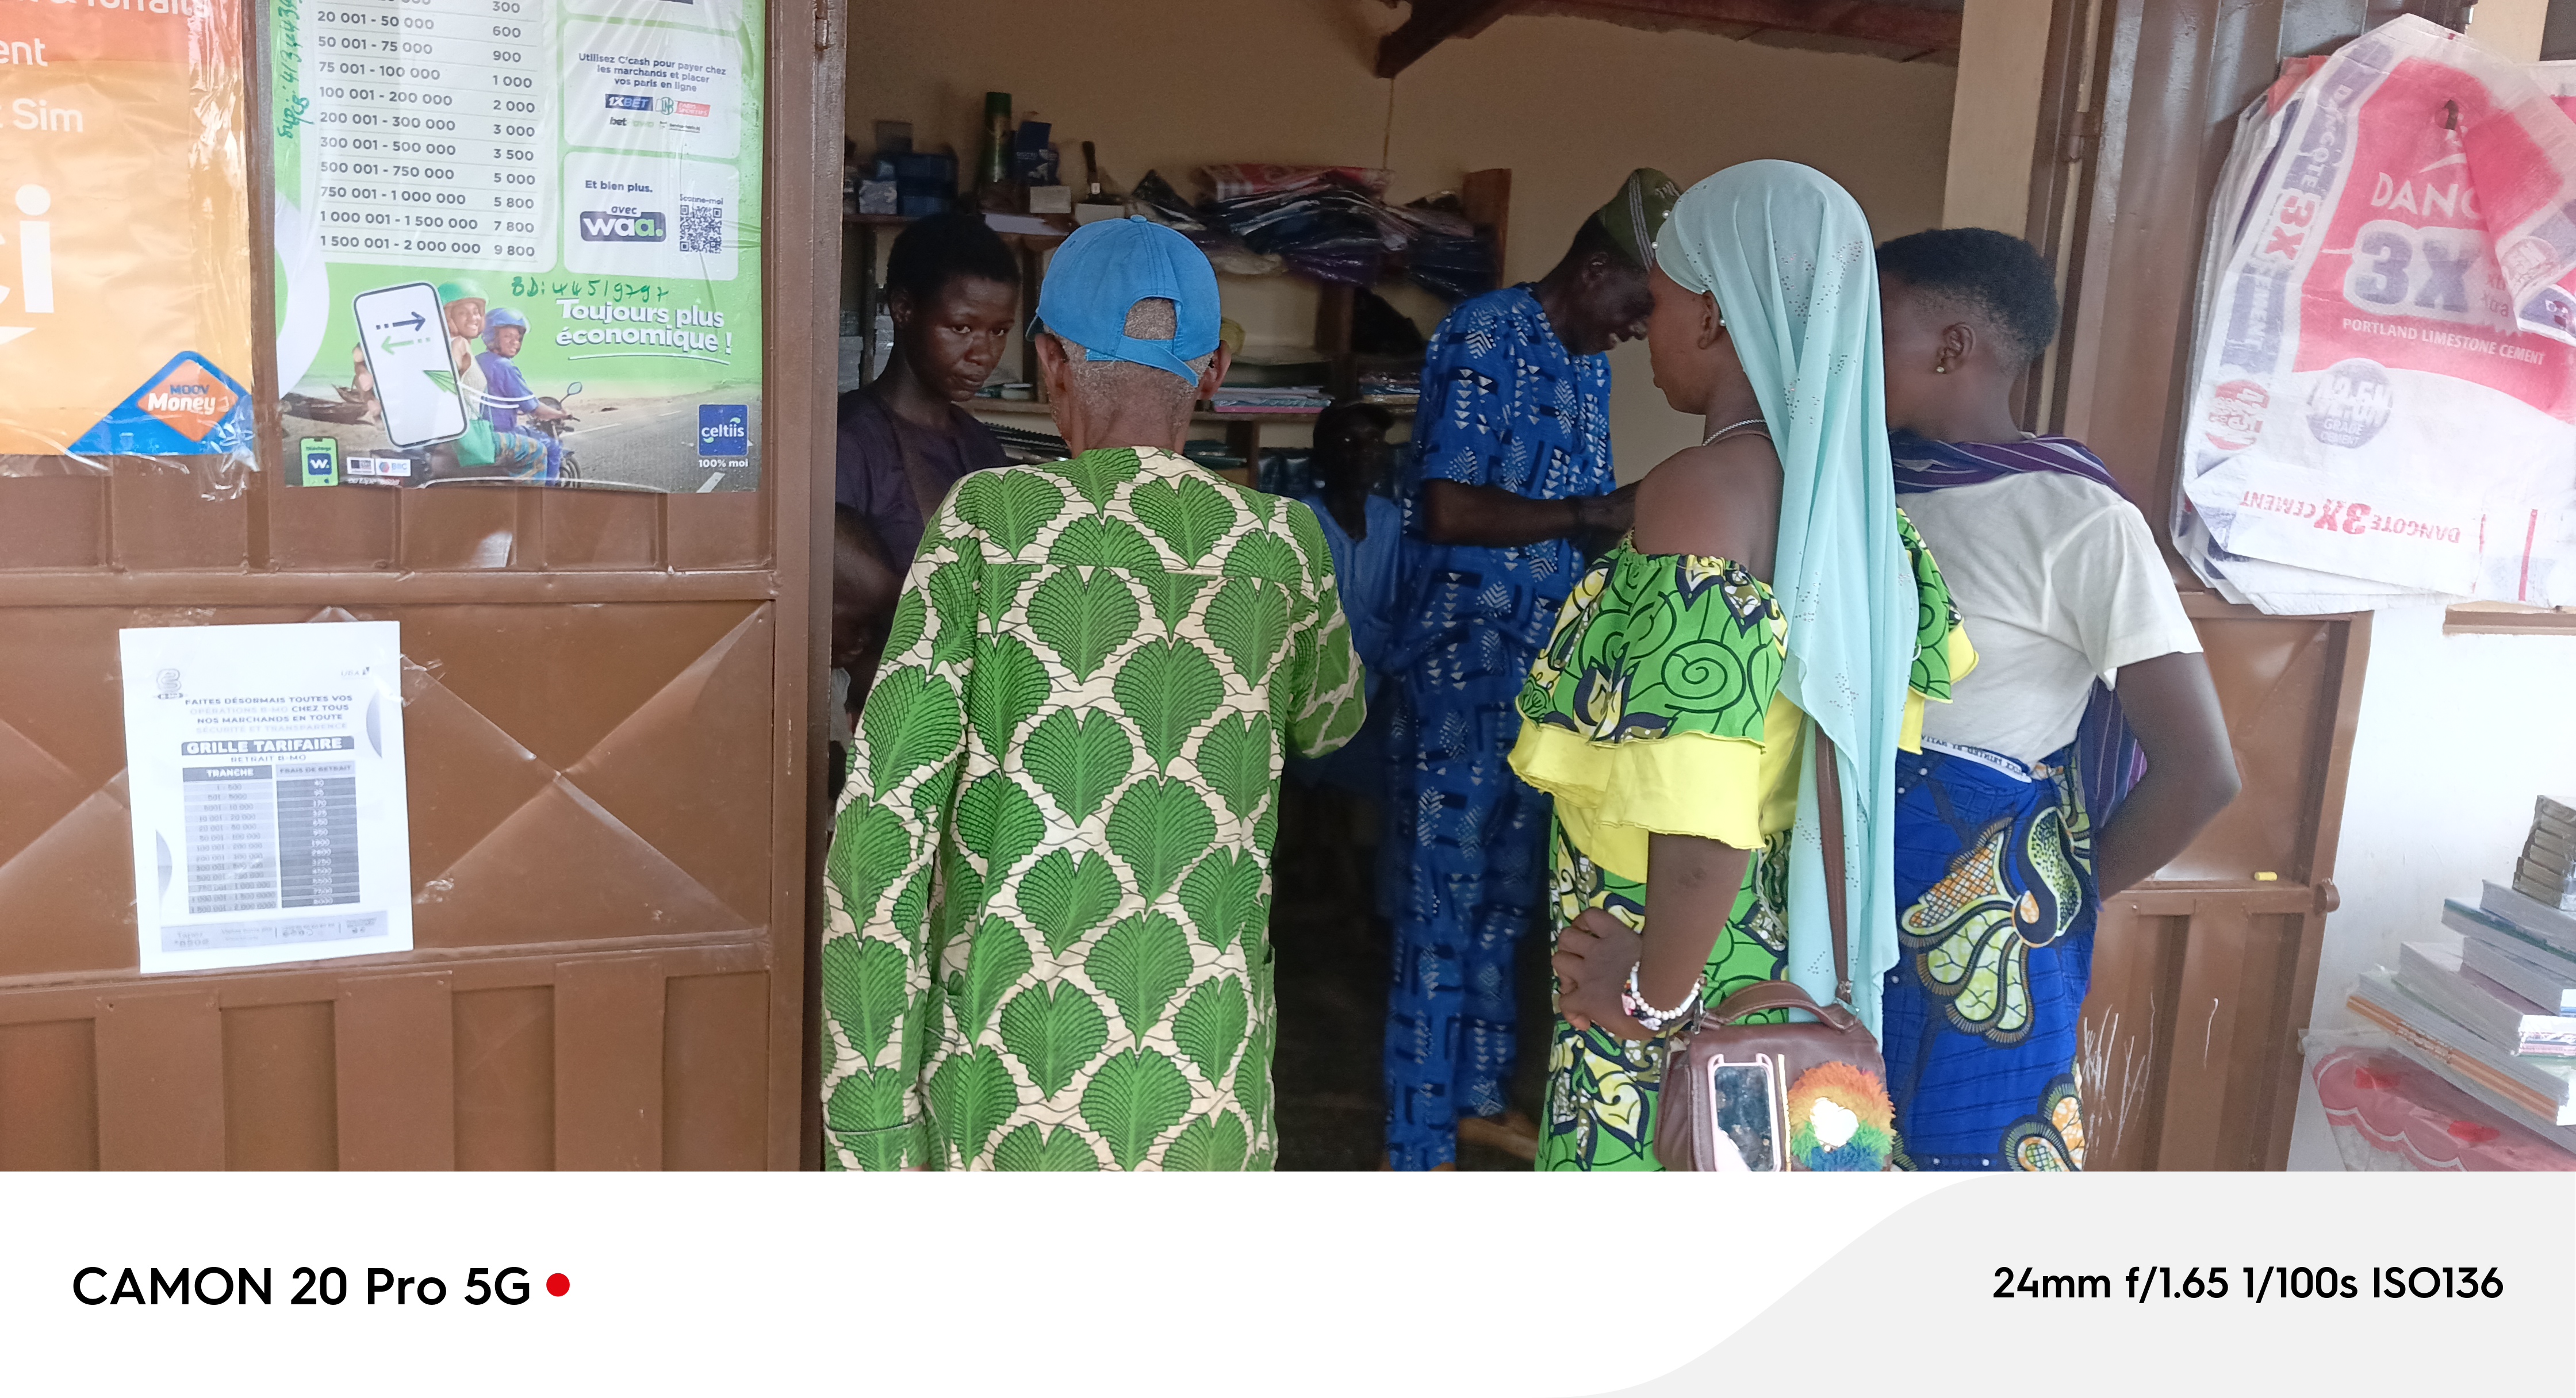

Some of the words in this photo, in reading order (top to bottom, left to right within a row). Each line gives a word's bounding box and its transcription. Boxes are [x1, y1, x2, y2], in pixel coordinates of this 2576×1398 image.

[492, 1, 520, 13] 300
[317, 10, 336, 22] 20
[340, 12, 366, 25] 001
[380, 15, 400, 27] 50
[404, 17, 435, 30] 000
[492, 25, 522, 39] 600
[318, 35, 336, 48] 50
[341, 37, 366, 50] 001
[381, 40, 398, 52] 75
[402, 41, 433, 55] 000
[493, 50, 522, 63] 900
[578, 53, 615, 63] Utilisez
[618, 56, 650, 66] C'cash
[653, 59, 676, 68] pour
[678, 62, 703, 72] payer
[706, 66, 726, 75] chez
[319, 61, 335, 73] 75
[339, 63, 365, 75] 001
[379, 65, 405, 78] 100
[409, 67, 441, 80] 000
[597, 64, 611, 73] les
[614, 66, 667, 78] marchands
[670, 70, 679, 78] et
[682, 73, 710, 83] placer
[492, 75, 499, 86] 1
[503, 75, 533, 89] 000
[634, 79, 657, 87] paris
[674, 81, 697, 91] ligne
[319, 86, 344, 99] 100
[349, 88, 374, 101] 001
[389, 91, 418, 103] 200
[422, 93, 453, 106] 000
[608, 97, 649, 108] 1XBET
[12, 98, 83, 132] Sim
[493, 99, 502, 110] 2
[505, 101, 535, 113] 000
[319, 112, 348, 124] 200
[352, 113, 378, 126] 001
[392, 116, 421, 128] 300
[425, 118, 456, 131] 000
[493, 124, 502, 135] 3
[505, 125, 535, 137] 000
[320, 136, 348, 149] 300
[352, 139, 378, 151] 001
[392, 141, 421, 153] 500
[425, 143, 457, 156] 000
[493, 148, 502, 159] 3
[505, 149, 534, 162] 500
[320, 161, 348, 174] 500
[352, 163, 378, 175] 001
[392, 165, 420, 178] 750
[424, 167, 455, 180] 000
[493, 172, 502, 183] 5
[506, 173, 536, 186] 000
[320, 186, 347, 198] 750
[351, 187, 377, 200] 001
[390, 190, 397, 201] 1
[401, 190, 432, 203] 000
[436, 193, 466, 205] 000
[585, 180, 597, 189] Et
[600, 181, 624, 190] bien
[627, 183, 653, 193] plus.
[493, 196, 502, 208] 5
[506, 197, 534, 209] 800
[611, 205, 638, 214] avec
[320, 210, 326, 221] 1
[330, 211, 361, 224] 000
[365, 213, 390, 225] 001
[404, 215, 411, 226] 1
[415, 216, 444, 228] 500
[448, 218, 478, 230] 000
[493, 220, 502, 231] 7
[506, 221, 535, 233] 800
[584, 218, 664, 237] waa.
[2264, 195, 2316, 260] 3X
[320, 235, 326, 247] 1
[331, 236, 359, 248] 500
[364, 237, 389, 249] 001
[403, 239, 412, 251] 2
[416, 240, 447, 252] 000
[451, 242, 481, 254] 000
[493, 244, 503, 255] 9
[507, 245, 535, 257] 800
[2355, 230, 2472, 314] 3X
[555, 297, 670, 324] Toujours
[675, 305, 724, 329] plus
[555, 327, 719, 352] économique
[2343, 317, 2417, 340] PORTLAND
[2421, 329, 2497, 355] LIMESTONE
[2499, 343, 2546, 366] CEMENT
[170, 385, 210, 395] MOOV
[148, 393, 216, 415] Money
[702, 424, 745, 437] celtiis
[2324, 417, 2364, 435] GRADE
[699, 459, 727, 468] 100%
[729, 459, 749, 467] moi
[2240, 490, 2317, 519] CEMENT
[2313, 498, 2372, 535] 3X
[2371, 514, 2462, 544] DANGOTE
[224, 696, 286, 705] DÉSORMAIS
[289, 695, 328, 703] TOUTES
[222, 715, 289, 723] MARCHANDS
[186, 741, 249, 755] GRILLE
[254, 738, 343, 752] TARIFAIRE
[206, 768, 255, 778] TRANCHE
